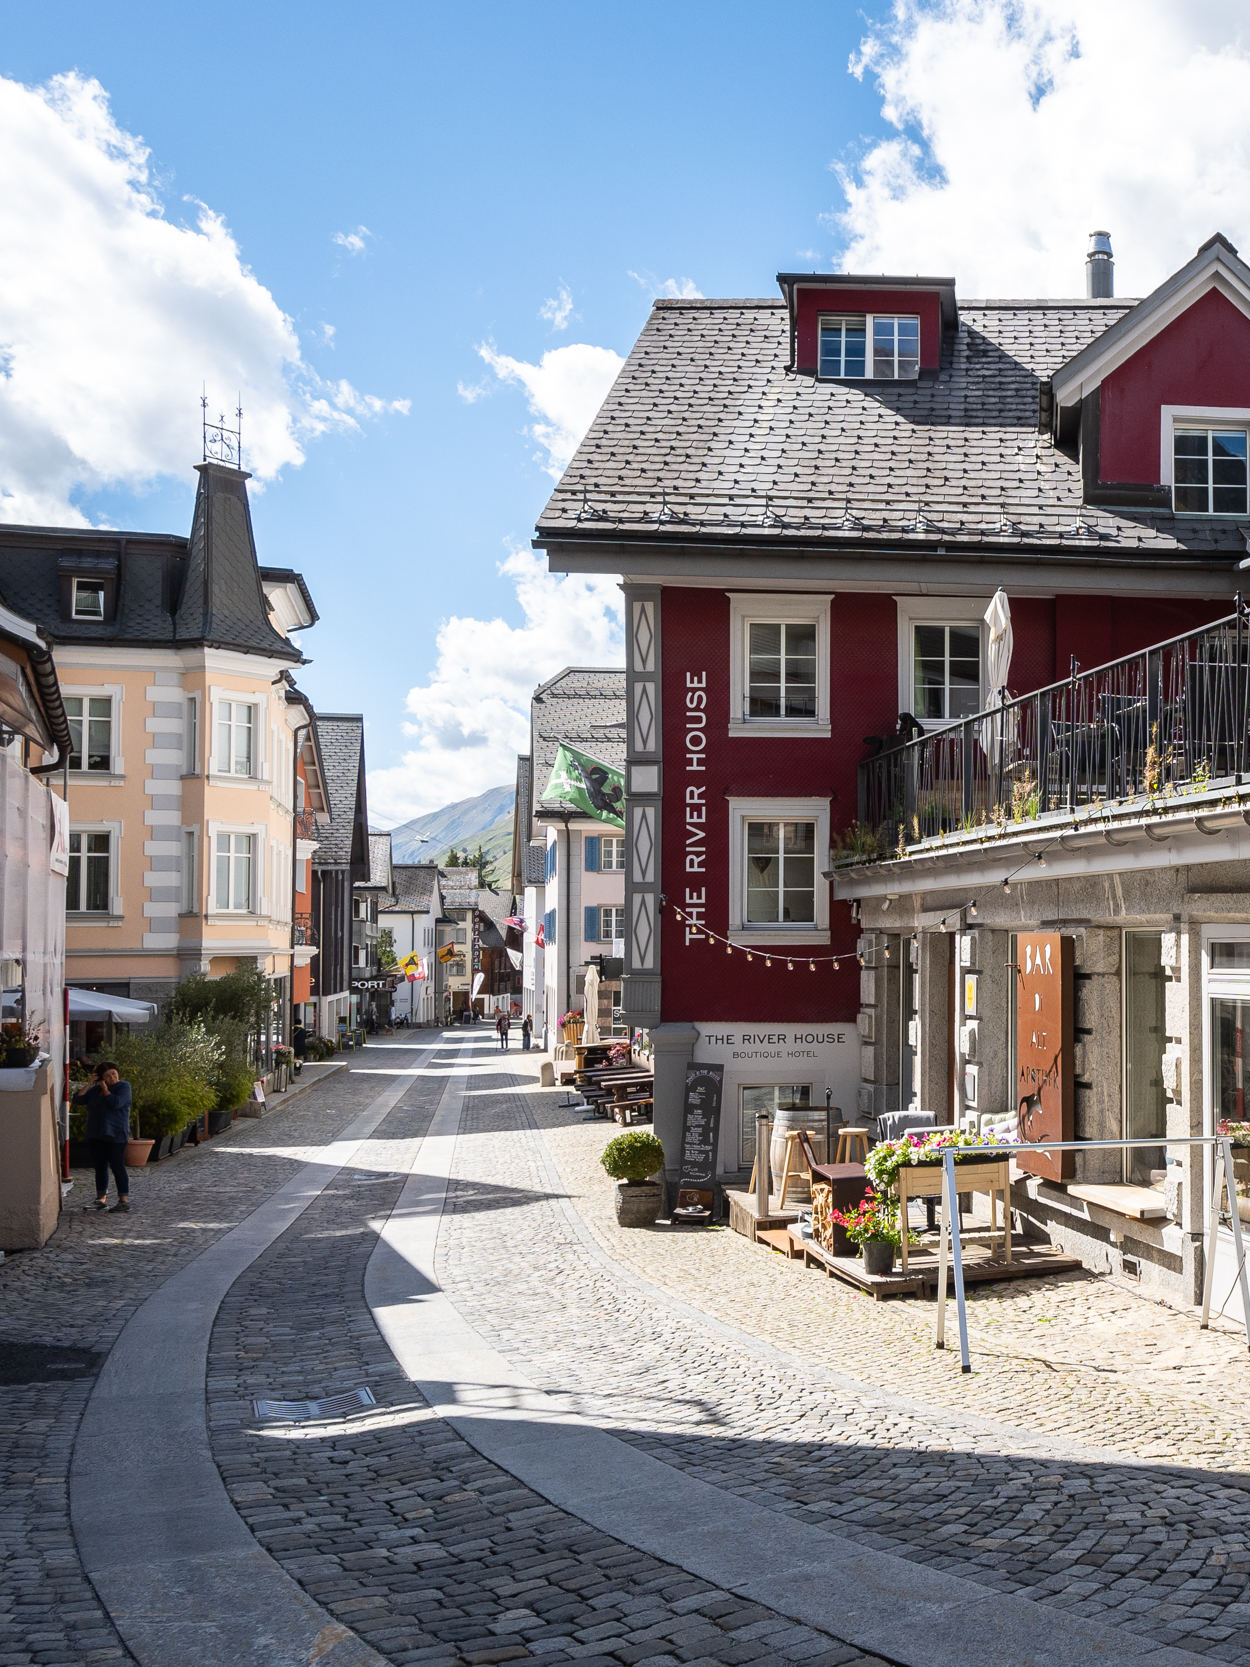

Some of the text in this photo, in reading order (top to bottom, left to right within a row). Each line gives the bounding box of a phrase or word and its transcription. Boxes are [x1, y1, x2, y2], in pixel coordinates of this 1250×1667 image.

[685, 671, 707, 946] THE RIVER HOUSE
[1025, 943, 1053, 975] BAR
[704, 1033, 846, 1045] THE RIVER HOUSE
[732, 1050, 819, 1059] BOUTIQUE HOTEL
